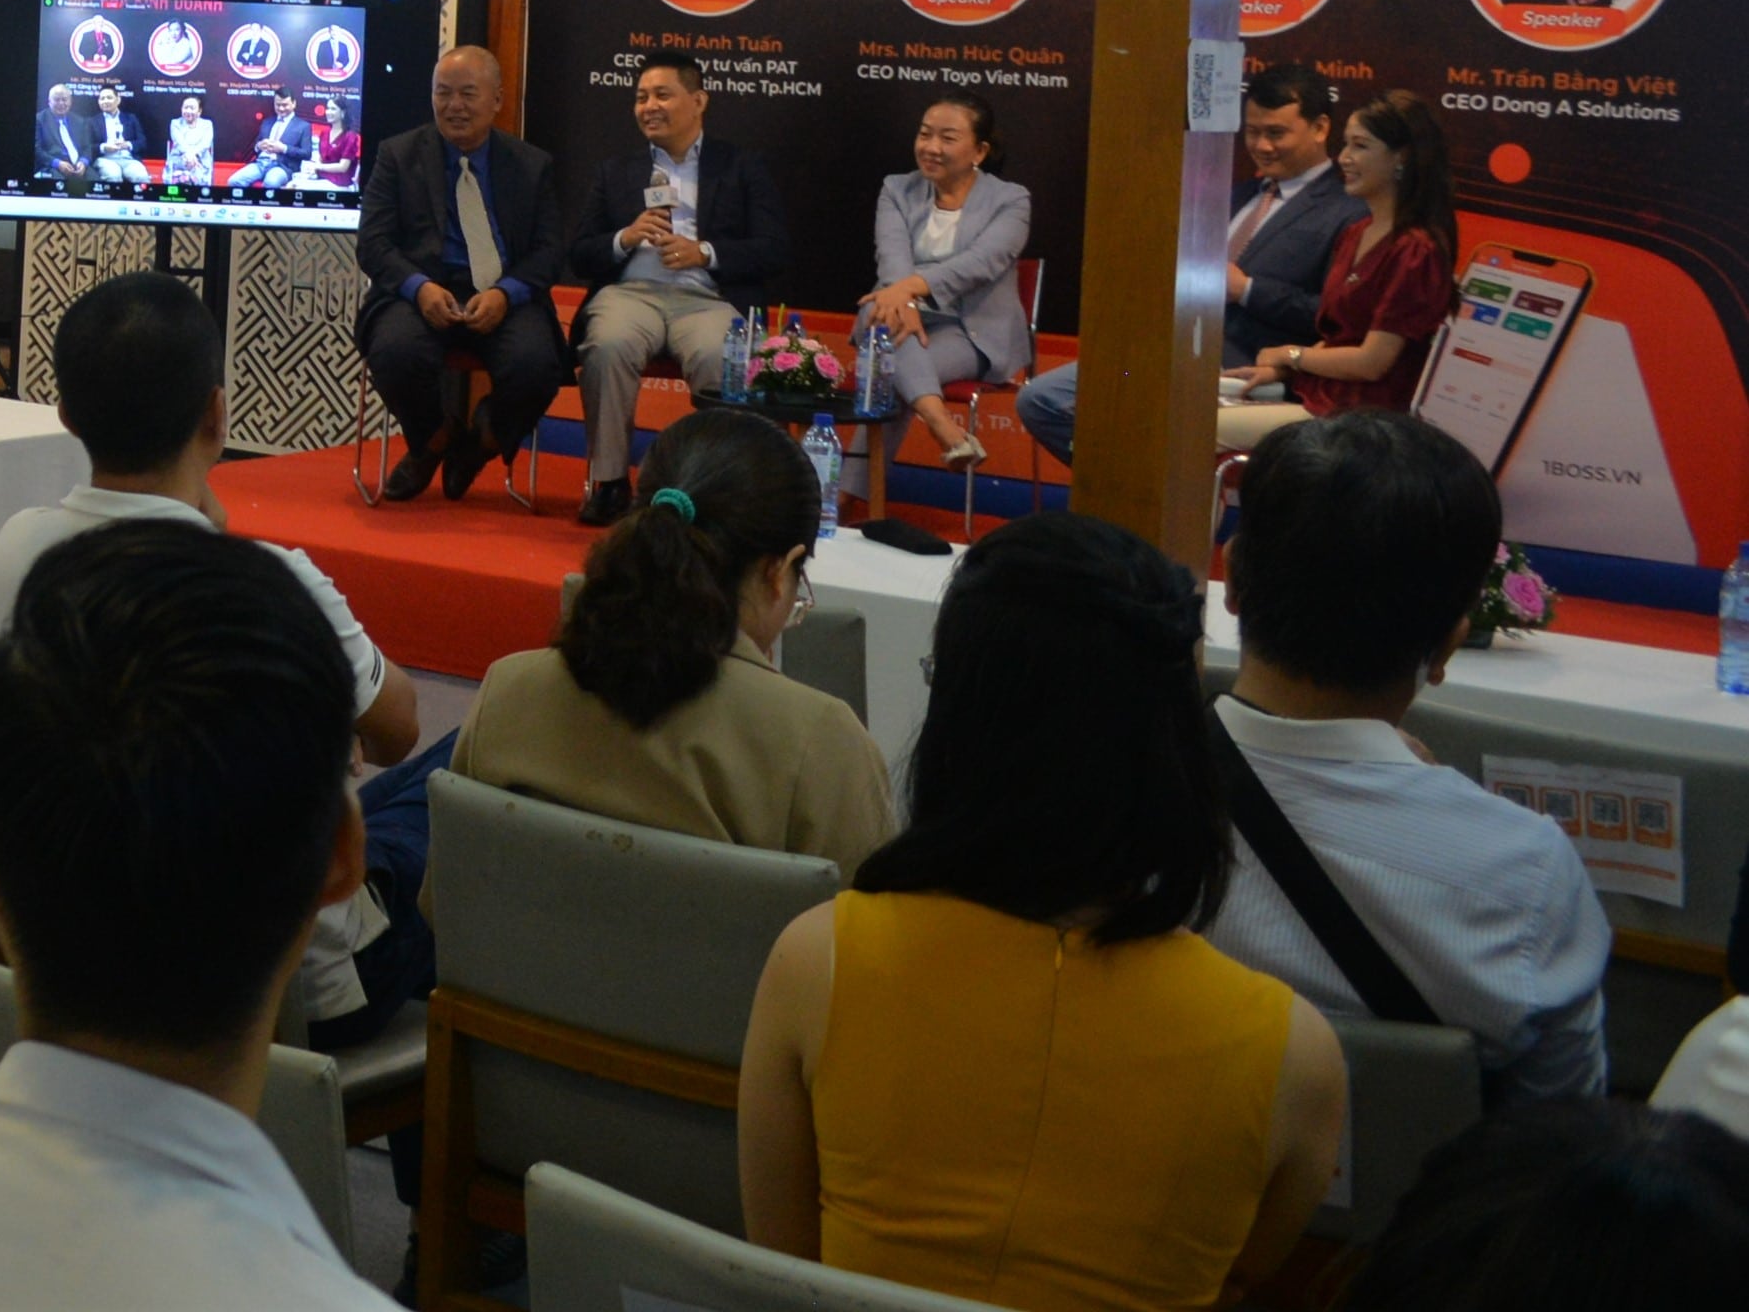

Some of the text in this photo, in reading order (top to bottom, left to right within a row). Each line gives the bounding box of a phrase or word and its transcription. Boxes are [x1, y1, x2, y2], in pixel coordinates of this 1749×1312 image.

[1241, 0, 1283, 15] aker
[1522, 10, 1603, 28] Speaker
[629, 32, 656, 48] Mr.
[695, 35, 732, 51] Anh
[859, 41, 899, 57] Mrs.
[905, 43, 957, 59] Nhan
[766, 60, 798, 75] PAT
[857, 64, 1068, 88] CEO New Toyo Viet Nam
[1447, 67, 1485, 85] Mr.
[726, 78, 756, 96] học
[759, 79, 822, 97] Tp.HCM
[1441, 92, 1681, 122] CEO Dong A Solutions
[1541, 459, 1643, 485] 1BOSS.VN
